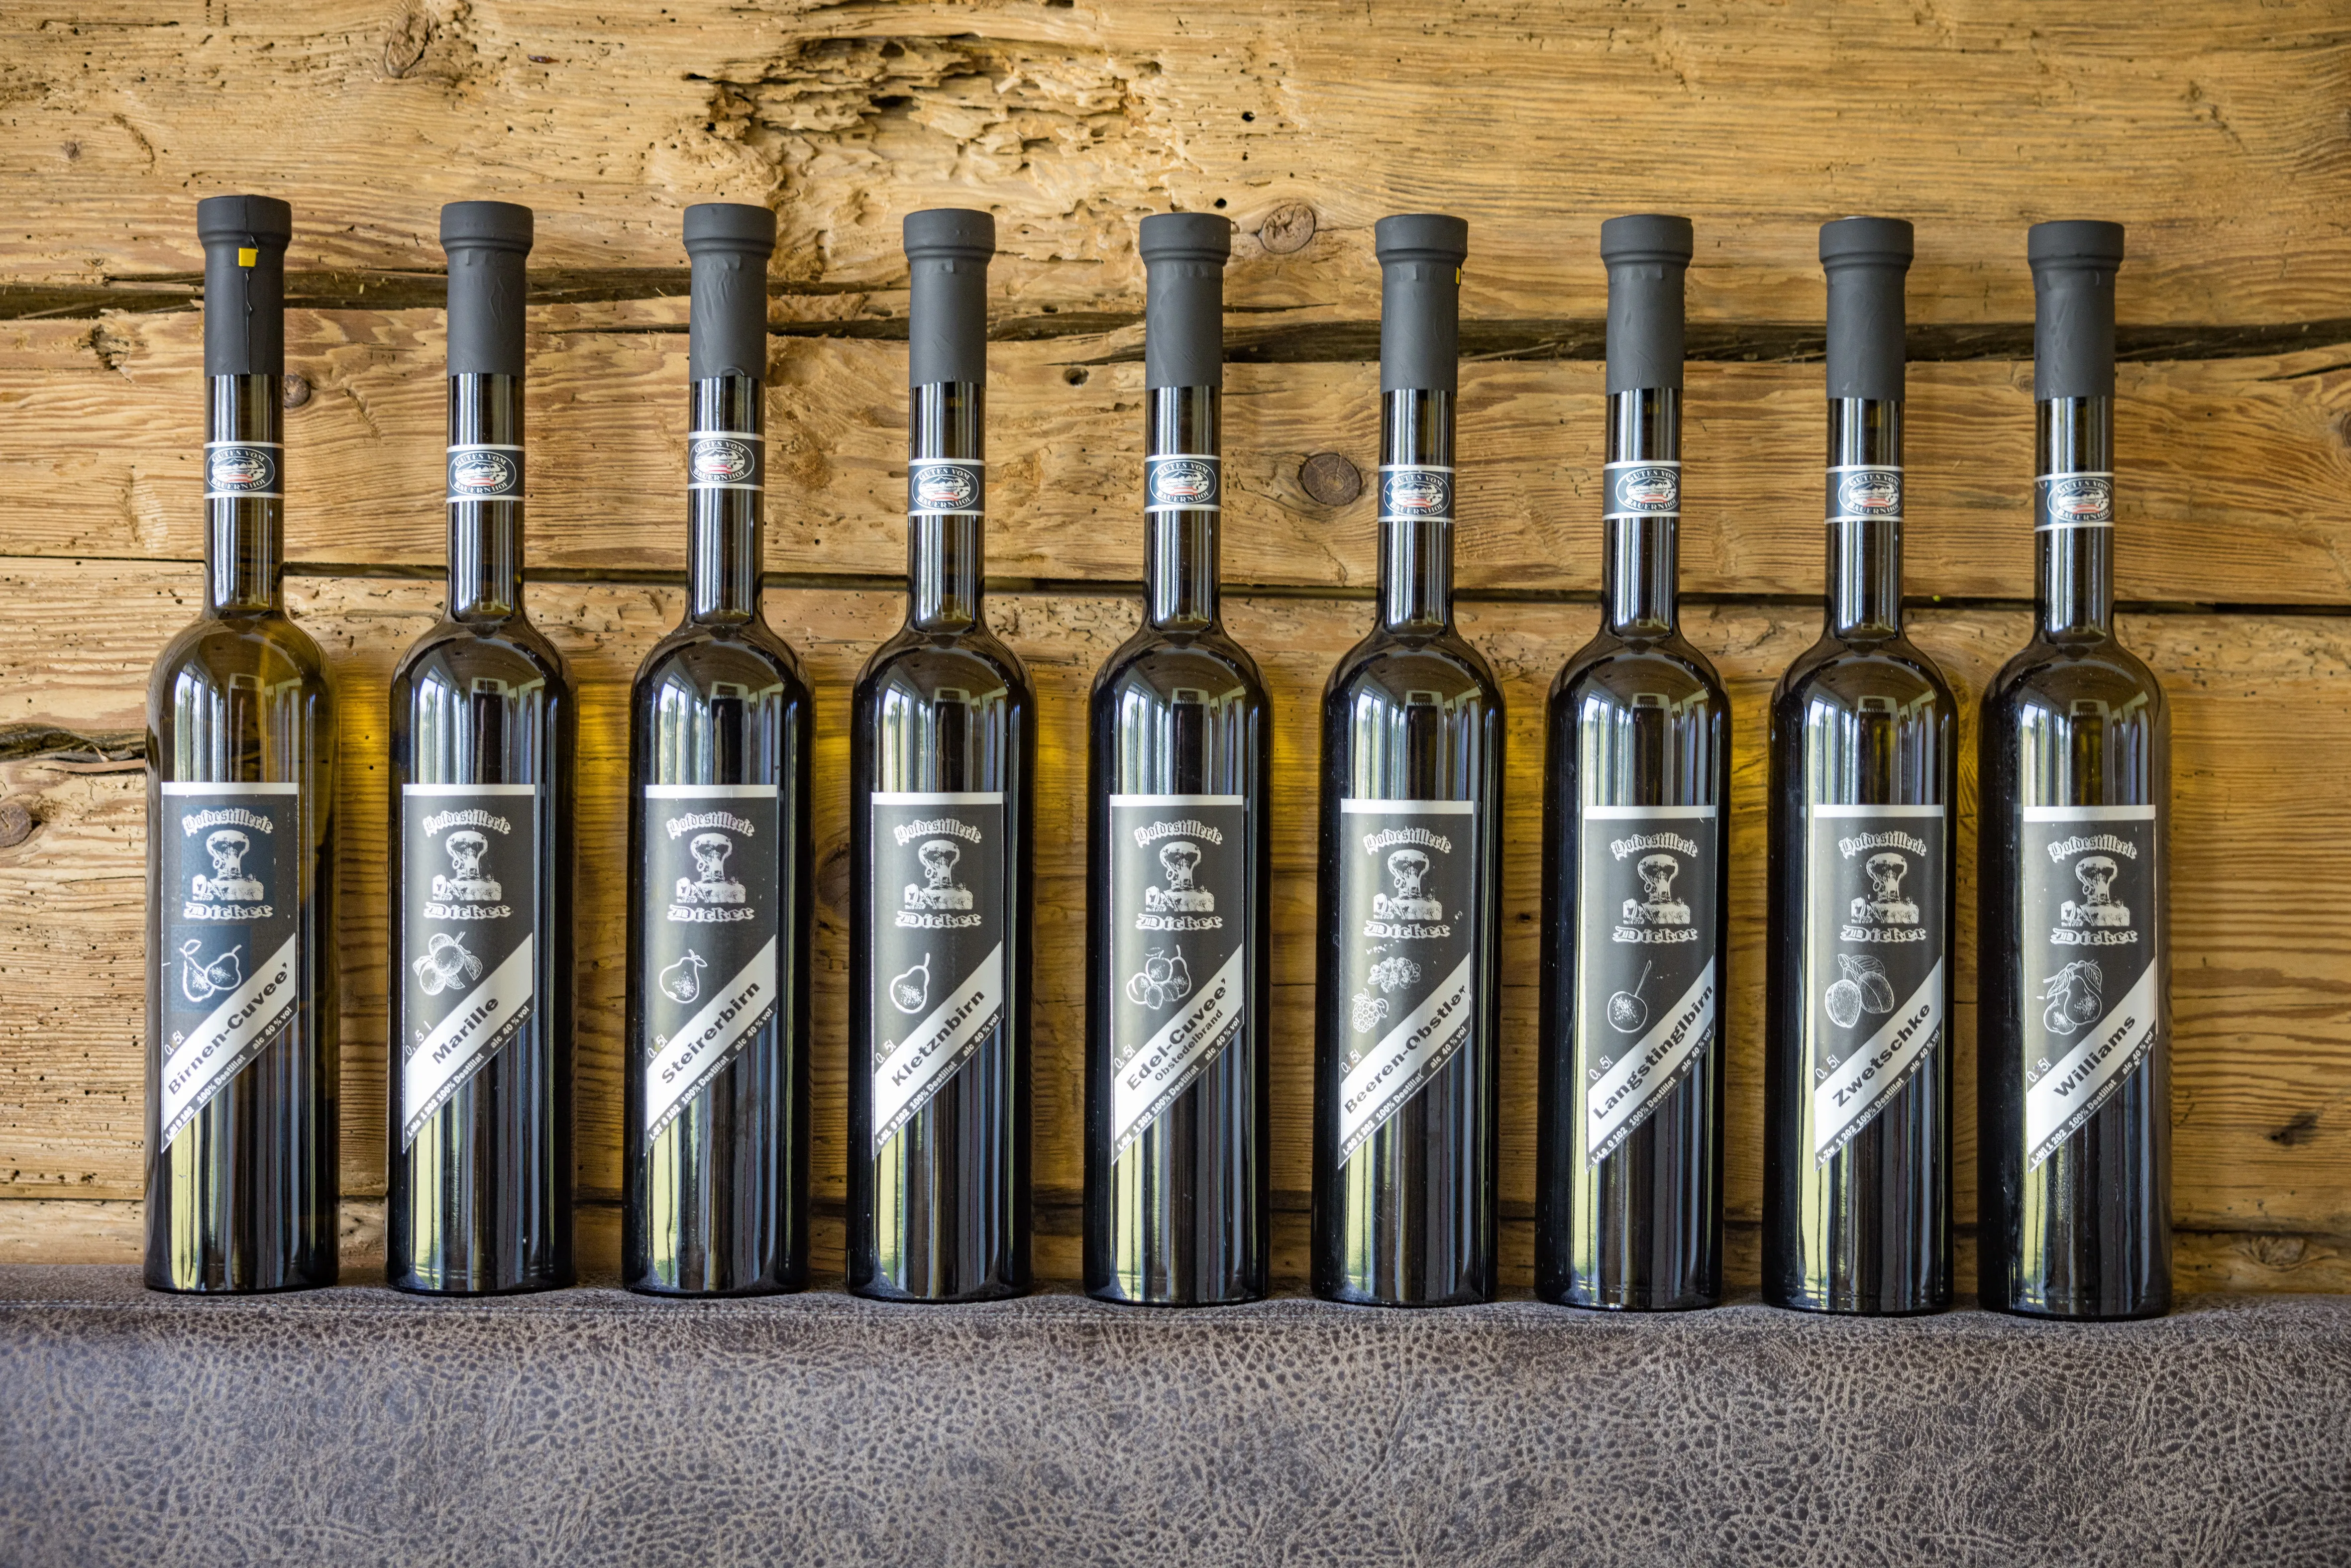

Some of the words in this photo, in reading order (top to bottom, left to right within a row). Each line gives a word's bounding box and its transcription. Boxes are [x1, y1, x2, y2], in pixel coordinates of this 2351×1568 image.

[211, 477, 266, 490] BAUERNHOF
[212, 448, 242, 462] GUTES
[245, 449, 265, 463] VOM
[455, 453, 484, 466] GUTES
[488, 453, 507, 465] VOM
[693, 469, 746, 482] BAUERNHOF
[695, 440, 723, 454] GUTES
[726, 442, 745, 454] VOM
[918, 468, 949, 481] GUTES
[952, 469, 970, 480] VOM
[1157, 462, 1187, 476] GUTES
[1191, 463, 1209, 476] VOM
[1391, 474, 1422, 487] GUTES
[1425, 475, 1444, 488] VOM
[1625, 470, 1658, 483] GUTES
[1661, 470, 1676, 482] VOM
[1848, 474, 1881, 487] GUTES
[1884, 474, 1899, 486] VOM
[453, 481, 508, 495] BAUERNHOF
[917, 495, 971, 508] BAUERNHOF
[1155, 490, 1209, 504] BAUERNHOF
[1389, 501, 1444, 515] BAUERNHOF
[2056, 481, 2090, 494] GUTES
[2093, 481, 2109, 494] VOM
[168, 962, 288, 1095] Birnen-Cuvee'
[197, 1083, 216, 1104] 100%
[214, 1054, 245, 1086] Destillat
[253, 1037, 264, 1049] alc
[265, 1025, 275, 1036] 40
[280, 1006, 292, 1019] vol
[432, 998, 499, 1064] Marille
[436, 1081, 455, 1102] 100%
[452, 1053, 484, 1084] Destillat
[491, 1036, 502, 1048] alc
[503, 1024, 513, 1035] 40
[518, 1005, 530, 1018] vol
[661, 982, 760, 1084] Steirerbirn
[681, 1084, 700, 1105] 100%
[698, 1056, 729, 1087] Destillat
[735, 1039, 747, 1050] alc
[747, 1026, 756, 1037] 40
[762, 1008, 772, 1020] vol
[891, 990, 984, 1087] Kletznbirn
[909, 1089, 929, 1110] 100%
[926, 1061, 957, 1092] Destillat
[963, 1044, 974, 1056] alc
[974, 1032, 984, 1043] 40
[988, 1013, 999, 1026] vol
[1126, 978, 1226, 1090] Edel-Cuvee'
[1155, 1010, 1223, 1081] Obstedelbrand
[1344, 985, 1466, 1114] Beeren-Obstler
[1593, 985, 1712, 1120] Langstinglbirn
[1832, 1004, 1929, 1107] Zwetschke
[2053, 1016, 2136, 1097] Williams
[1138, 1112, 1153, 1128] 202
[1151, 1094, 1171, 1114] 100%
[1168, 1065, 1199, 1096] Destillat
[1205, 1047, 1216, 1060] alc
[1216, 1036, 1225, 1046] 40
[1230, 1017, 1239, 1030] vol
[1361, 1120, 1375, 1136] 202
[1376, 1100, 1395, 1121] 100%
[1392, 1072, 1423, 1104] Destillat
[1430, 1056, 1441, 1068] alc
[1442, 1044, 1451, 1054] 40
[1456, 1026, 1466, 1039] vol
[1612, 1127, 1627, 1143] 102
[1629, 1106, 1648, 1126] 100%
[1646, 1076, 1676, 1108] Destillat
[1682, 1059, 1691, 1072] alc
[1692, 1047, 1700, 1058] 40
[1841, 1125, 1856, 1141] 202
[1856, 1107, 1876, 1127] 100%
[1874, 1077, 1904, 1109] Destillat
[1910, 1060, 1920, 1073] alc
[1920, 1048, 1928, 1059] 40
[2051, 1129, 2066, 1145] 202
[2069, 1108, 2088, 1129] 100%
[2086, 1079, 2117, 1110] Destillat
[2123, 1062, 2132, 1074] alc
[2133, 1049, 2141, 1060] 40
[2144, 1031, 2153, 1044] vol
